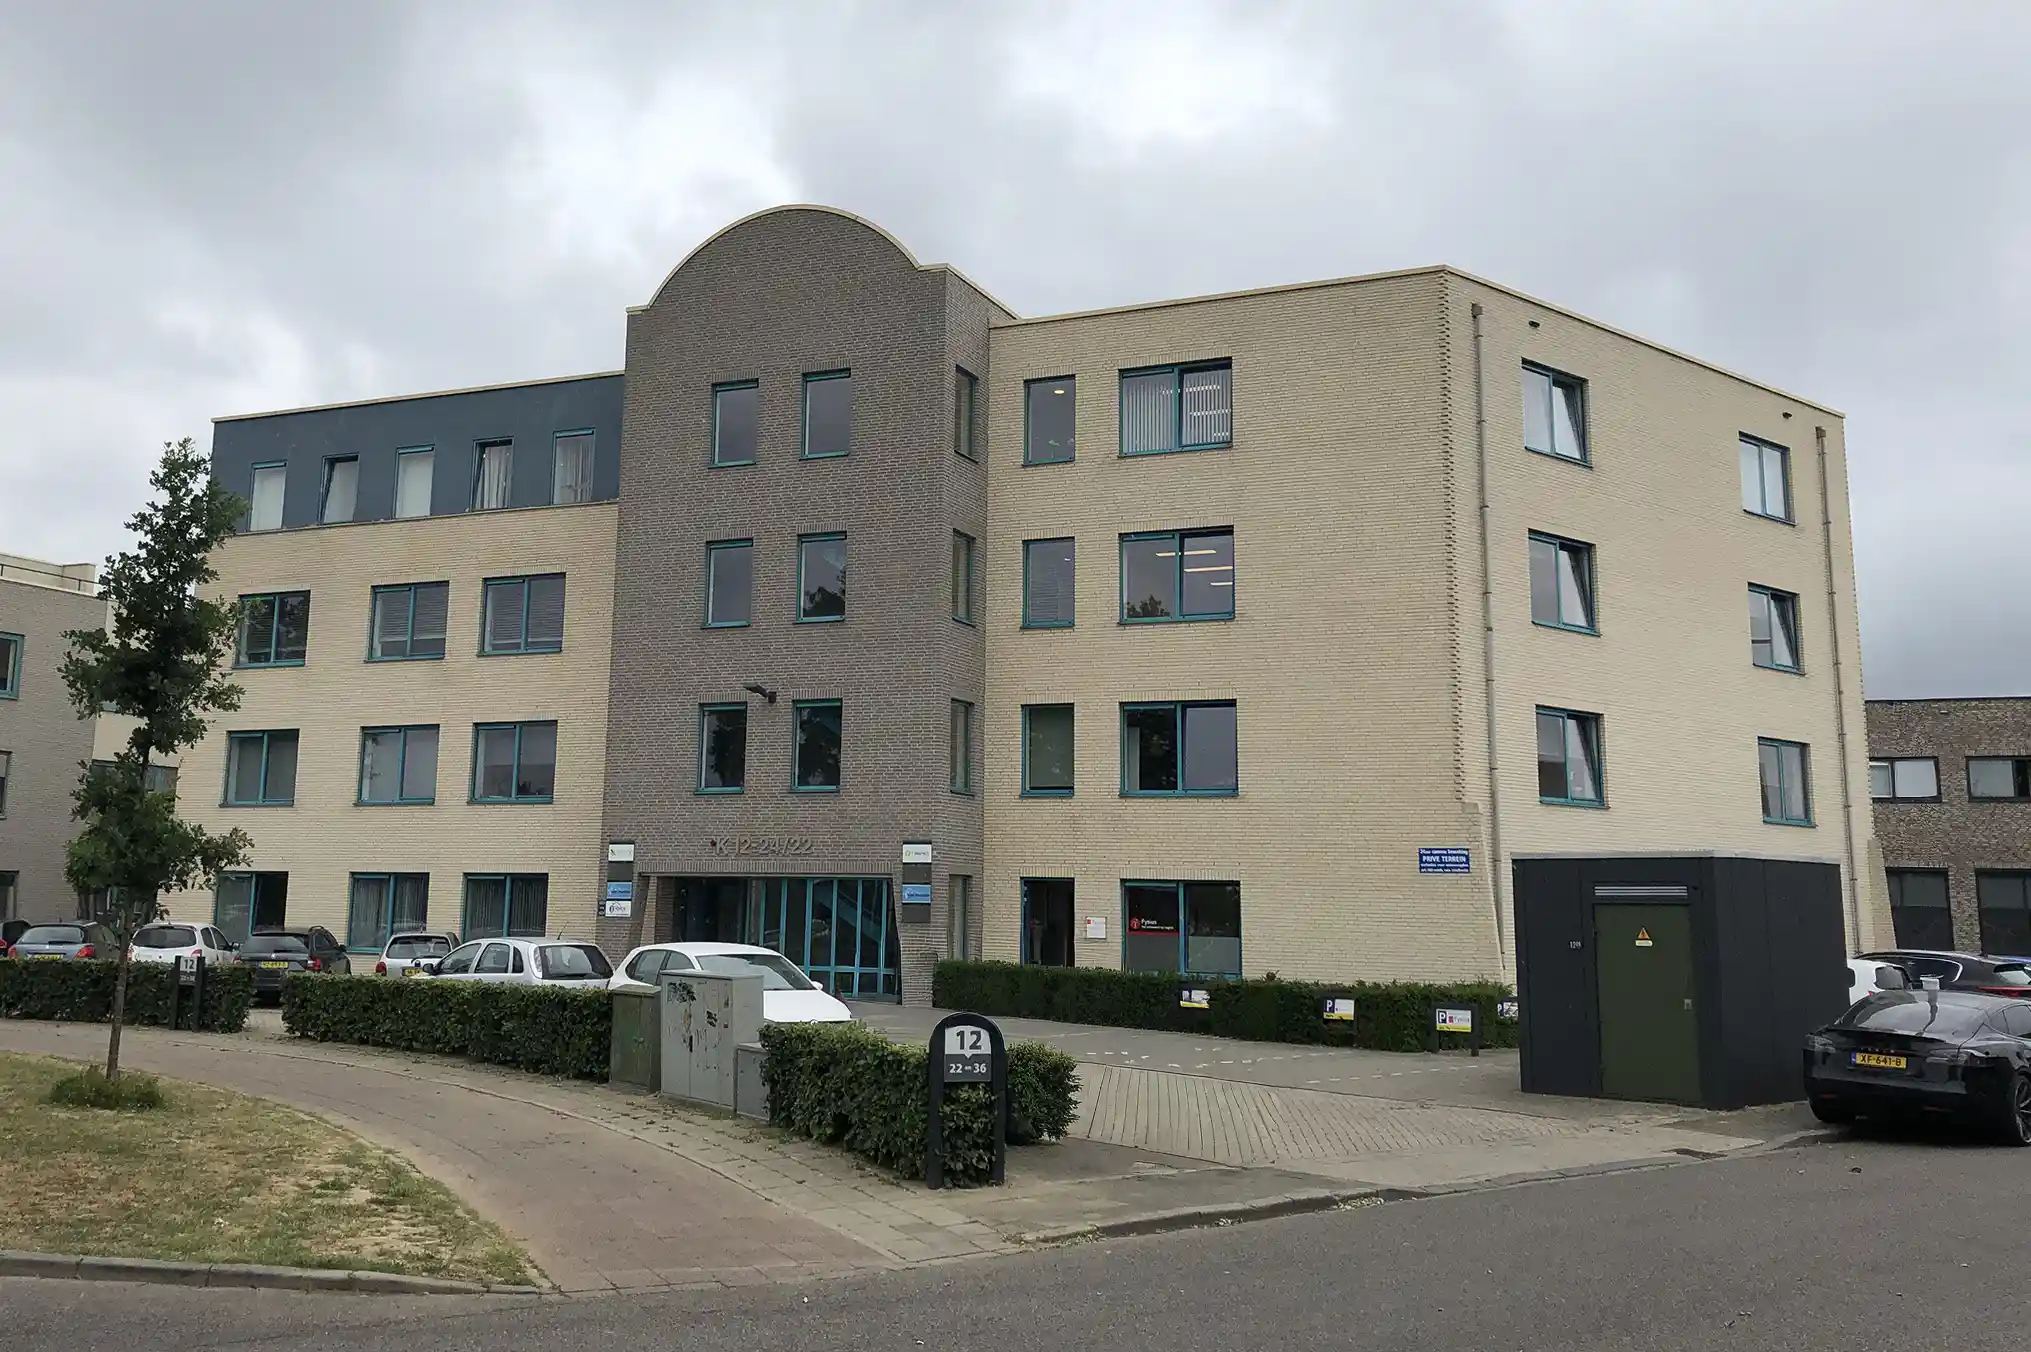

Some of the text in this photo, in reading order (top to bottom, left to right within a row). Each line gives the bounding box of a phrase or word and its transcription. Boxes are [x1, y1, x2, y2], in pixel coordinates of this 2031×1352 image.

[1441, 855, 1467, 863] TERREIN
[184, 958, 196, 970] 12
[1326, 999, 1333, 1012] P
[1439, 1011, 1446, 1023] P
[956, 1030, 982, 1051] 12
[949, 1063, 963, 1074] 22
[973, 1063, 987, 1073] 36
